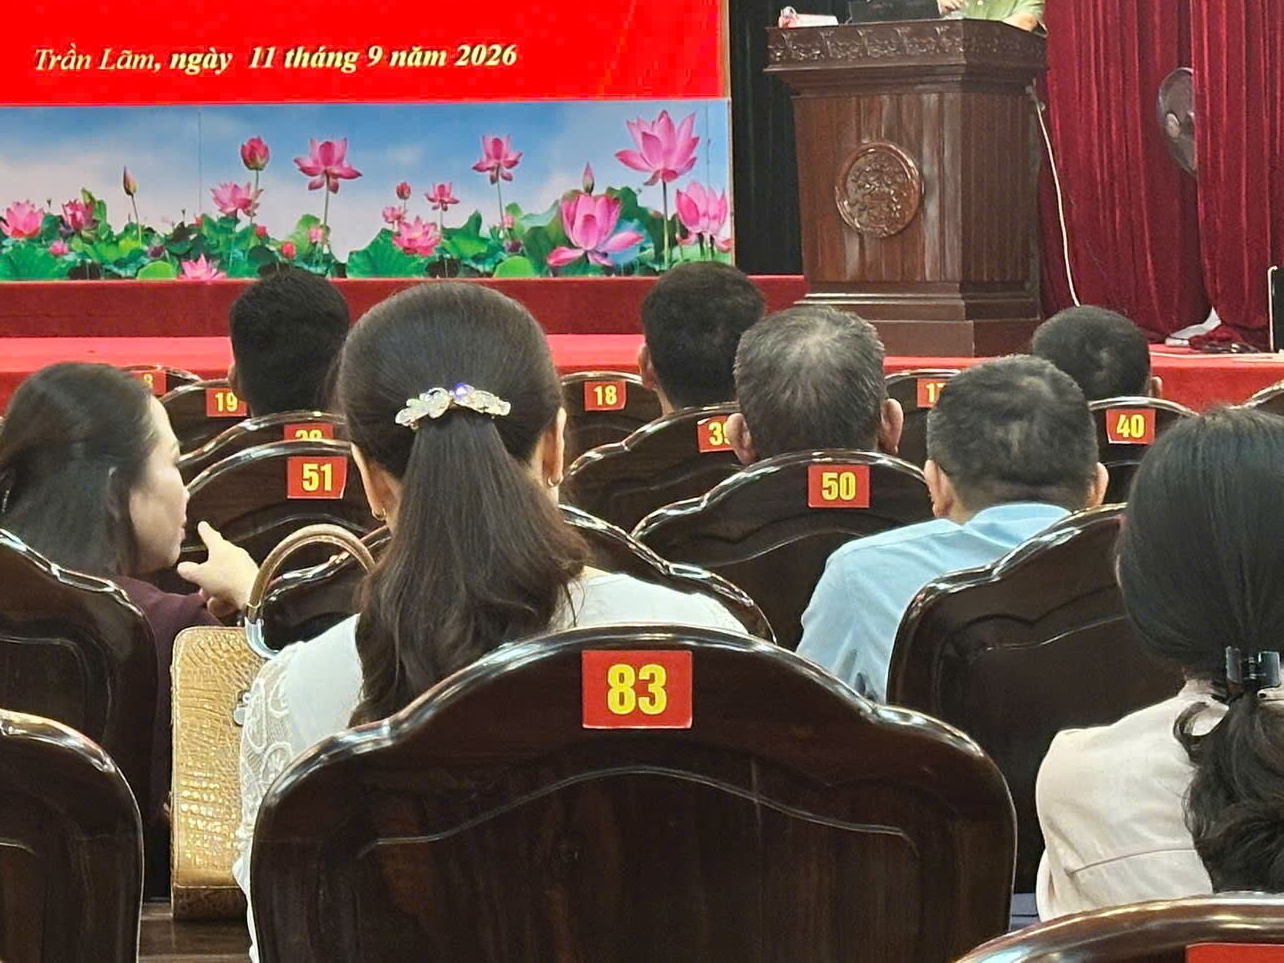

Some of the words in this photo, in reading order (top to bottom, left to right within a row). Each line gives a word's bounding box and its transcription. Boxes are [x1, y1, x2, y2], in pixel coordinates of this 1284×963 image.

[35, 43, 93, 71] Trần
[169, 47, 234, 76] ngày
[250, 47, 277, 70] 11
[284, 45, 361, 74] tháng
[367, 46, 385, 68] 9
[390, 46, 448, 68] năm
[454, 44, 519, 67] 2026
[215, 391, 239, 412] 19
[594, 385, 618, 406] 18
[1116, 413, 1146, 439] 40
[302, 463, 333, 492] 51
[820, 472, 858, 501] 50
[606, 663, 669, 717] 83
